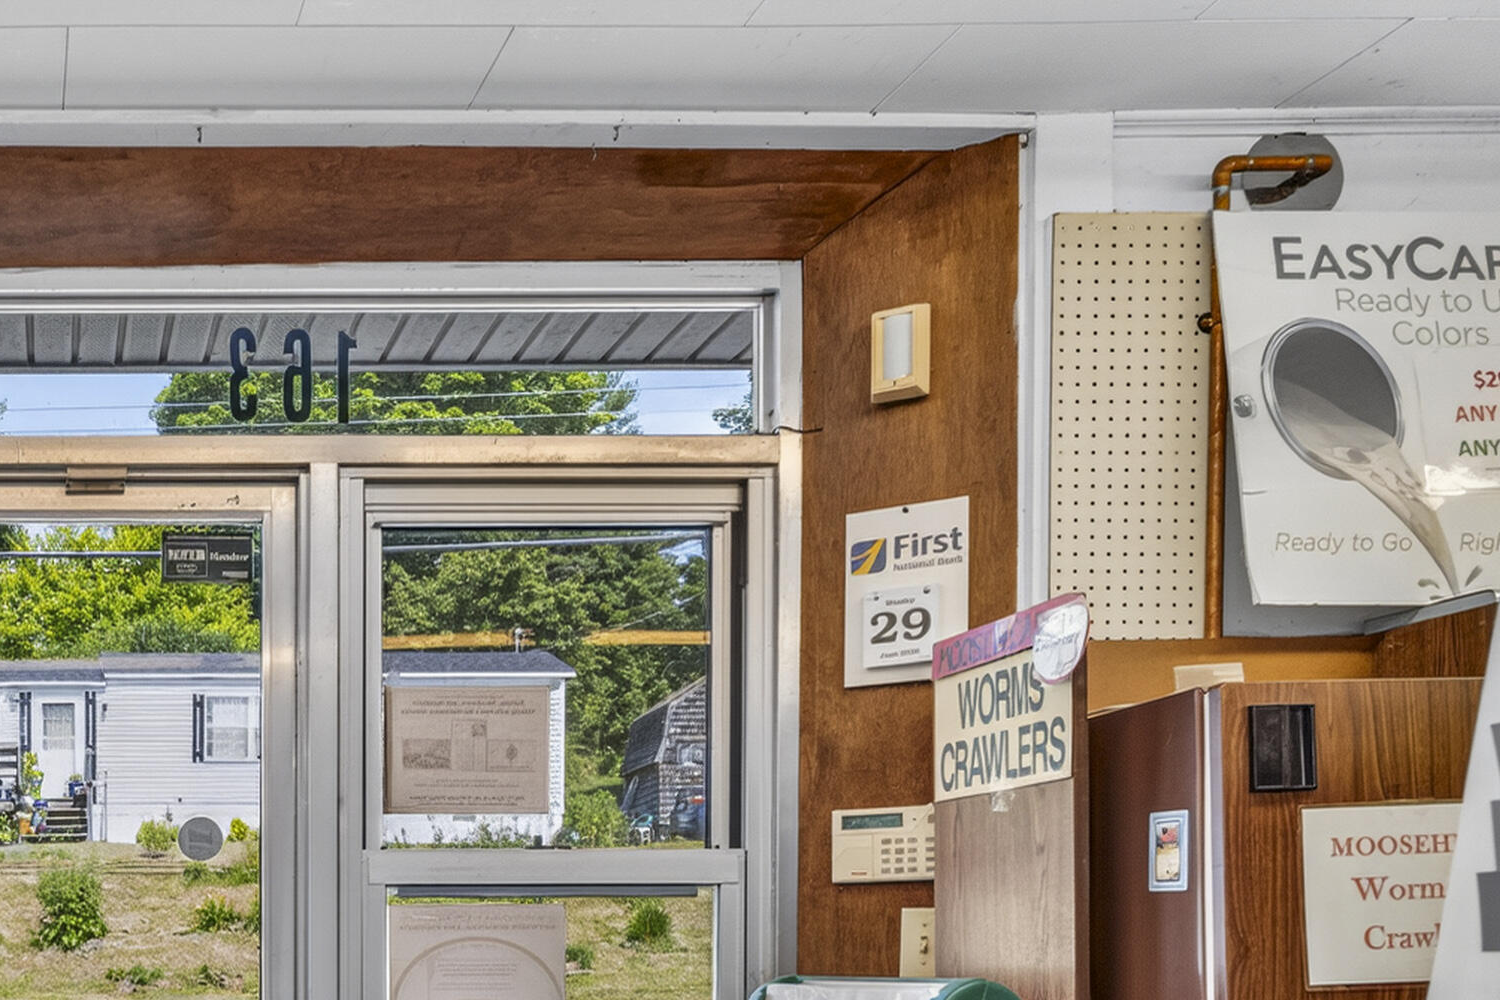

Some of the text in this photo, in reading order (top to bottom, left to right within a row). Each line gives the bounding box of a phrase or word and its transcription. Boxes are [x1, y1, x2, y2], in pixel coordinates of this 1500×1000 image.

[1335, 287, 1430, 318] Ready
[1441, 290, 1472, 313] to
[1392, 321, 1490, 346] Colors
[1455, 405, 1498, 424] ANY
[1458, 440, 1500, 457] ANY
[894, 527, 963, 560] First
[1275, 532, 1412, 555] Ready to Go
[870, 607, 932, 644] 29
[958, 663, 1044, 729] WORMS
[941, 716, 1066, 792] CRAWLERS
[1330, 833, 1458, 858] MOOSEH
[1351, 876, 1446, 901] Worm
